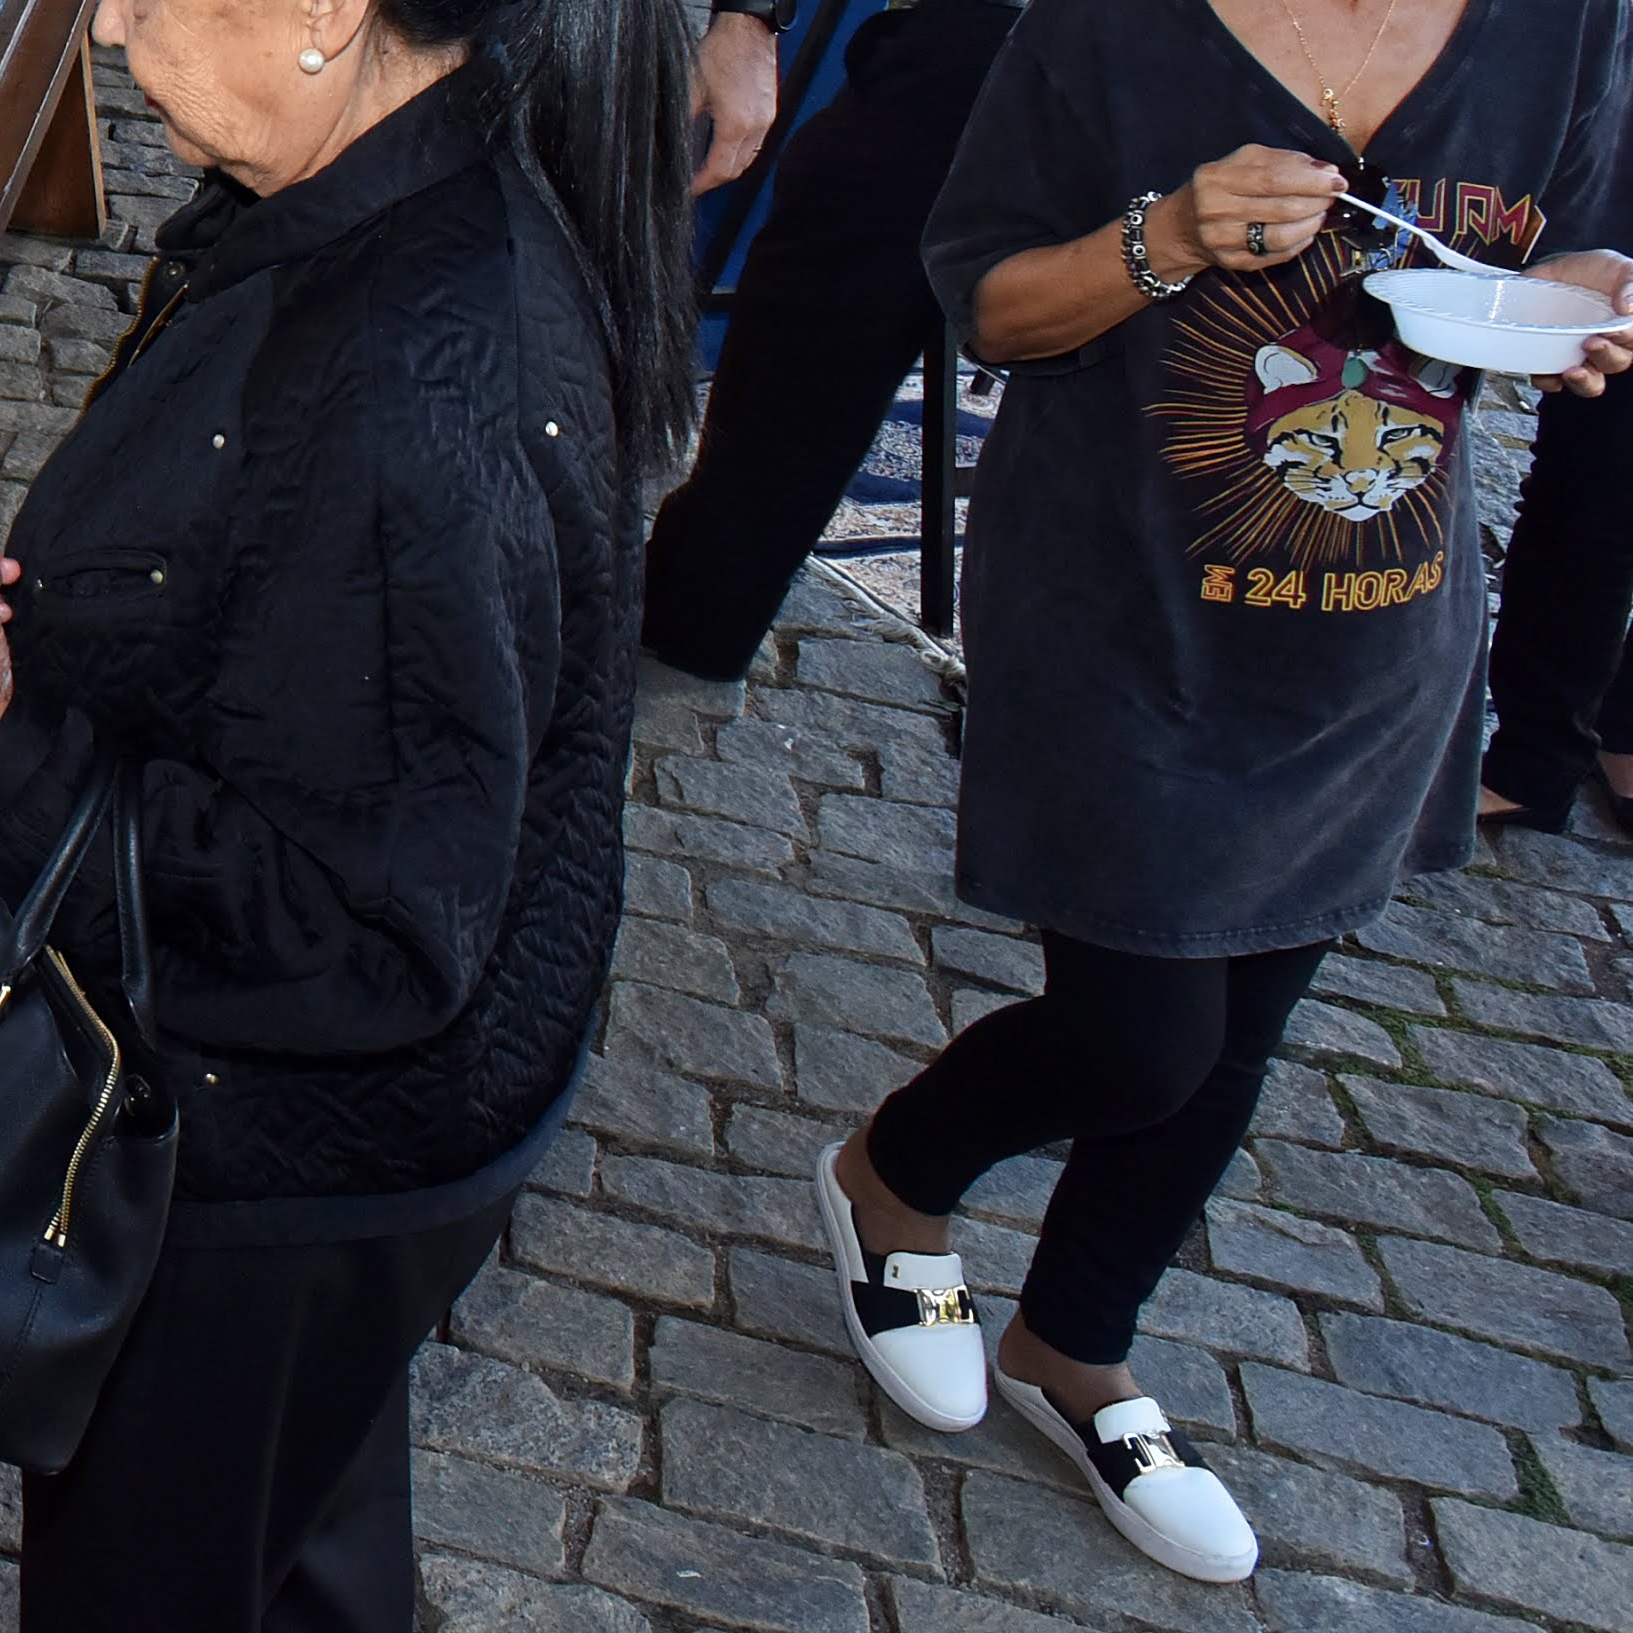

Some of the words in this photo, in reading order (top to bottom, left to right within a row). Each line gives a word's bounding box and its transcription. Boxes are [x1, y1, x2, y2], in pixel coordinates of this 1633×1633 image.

[1201, 563, 1236, 603] EM
[1244, 567, 1307, 609] 24
[1321, 552, 1445, 612] HORAS
